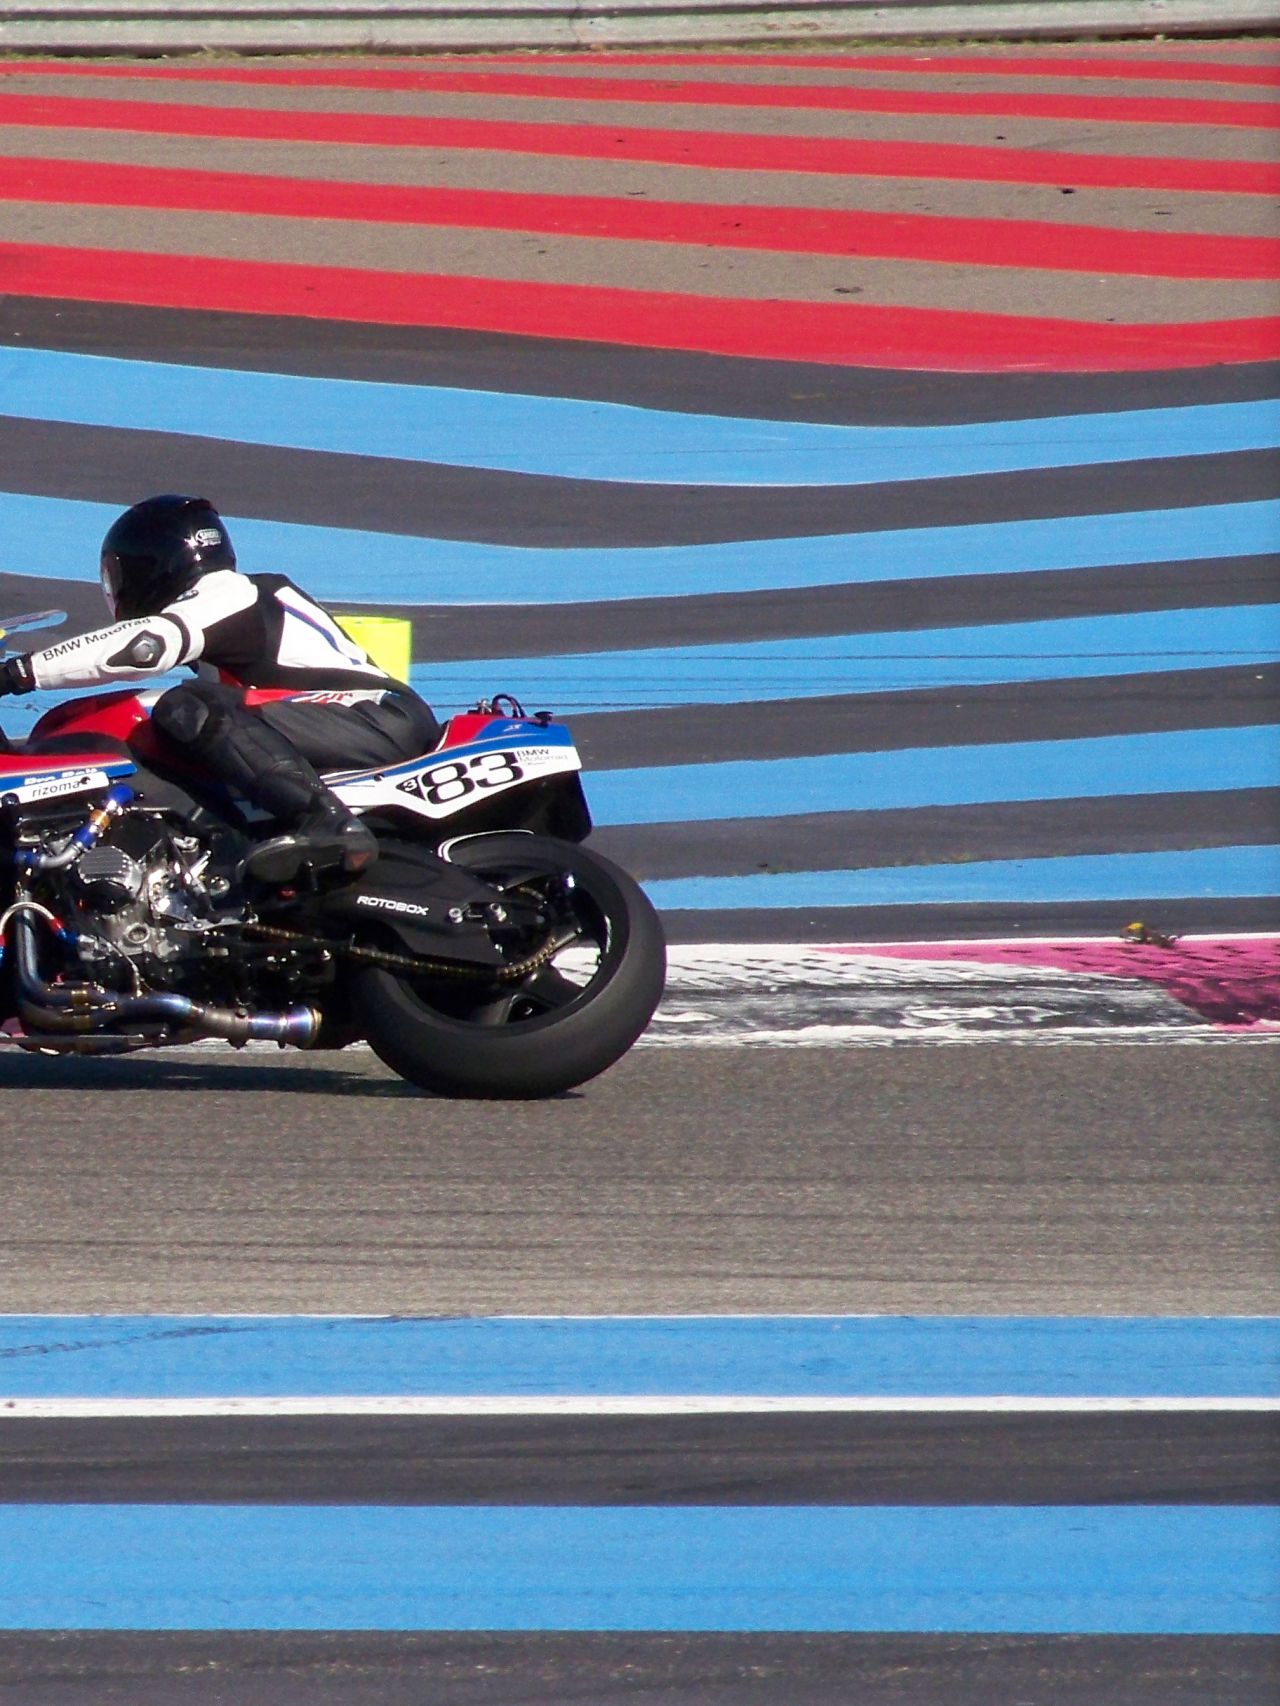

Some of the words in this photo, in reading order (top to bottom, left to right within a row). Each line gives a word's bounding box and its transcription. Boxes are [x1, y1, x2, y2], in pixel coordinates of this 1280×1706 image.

[42, 638, 82, 662] BMW
[84, 617, 152, 645] Motorrad
[403, 778, 418, 791] 3
[421, 752, 524, 804] 83
[32, 781, 81, 797] rizoma
[356, 895, 430, 916] ROTOBOX
